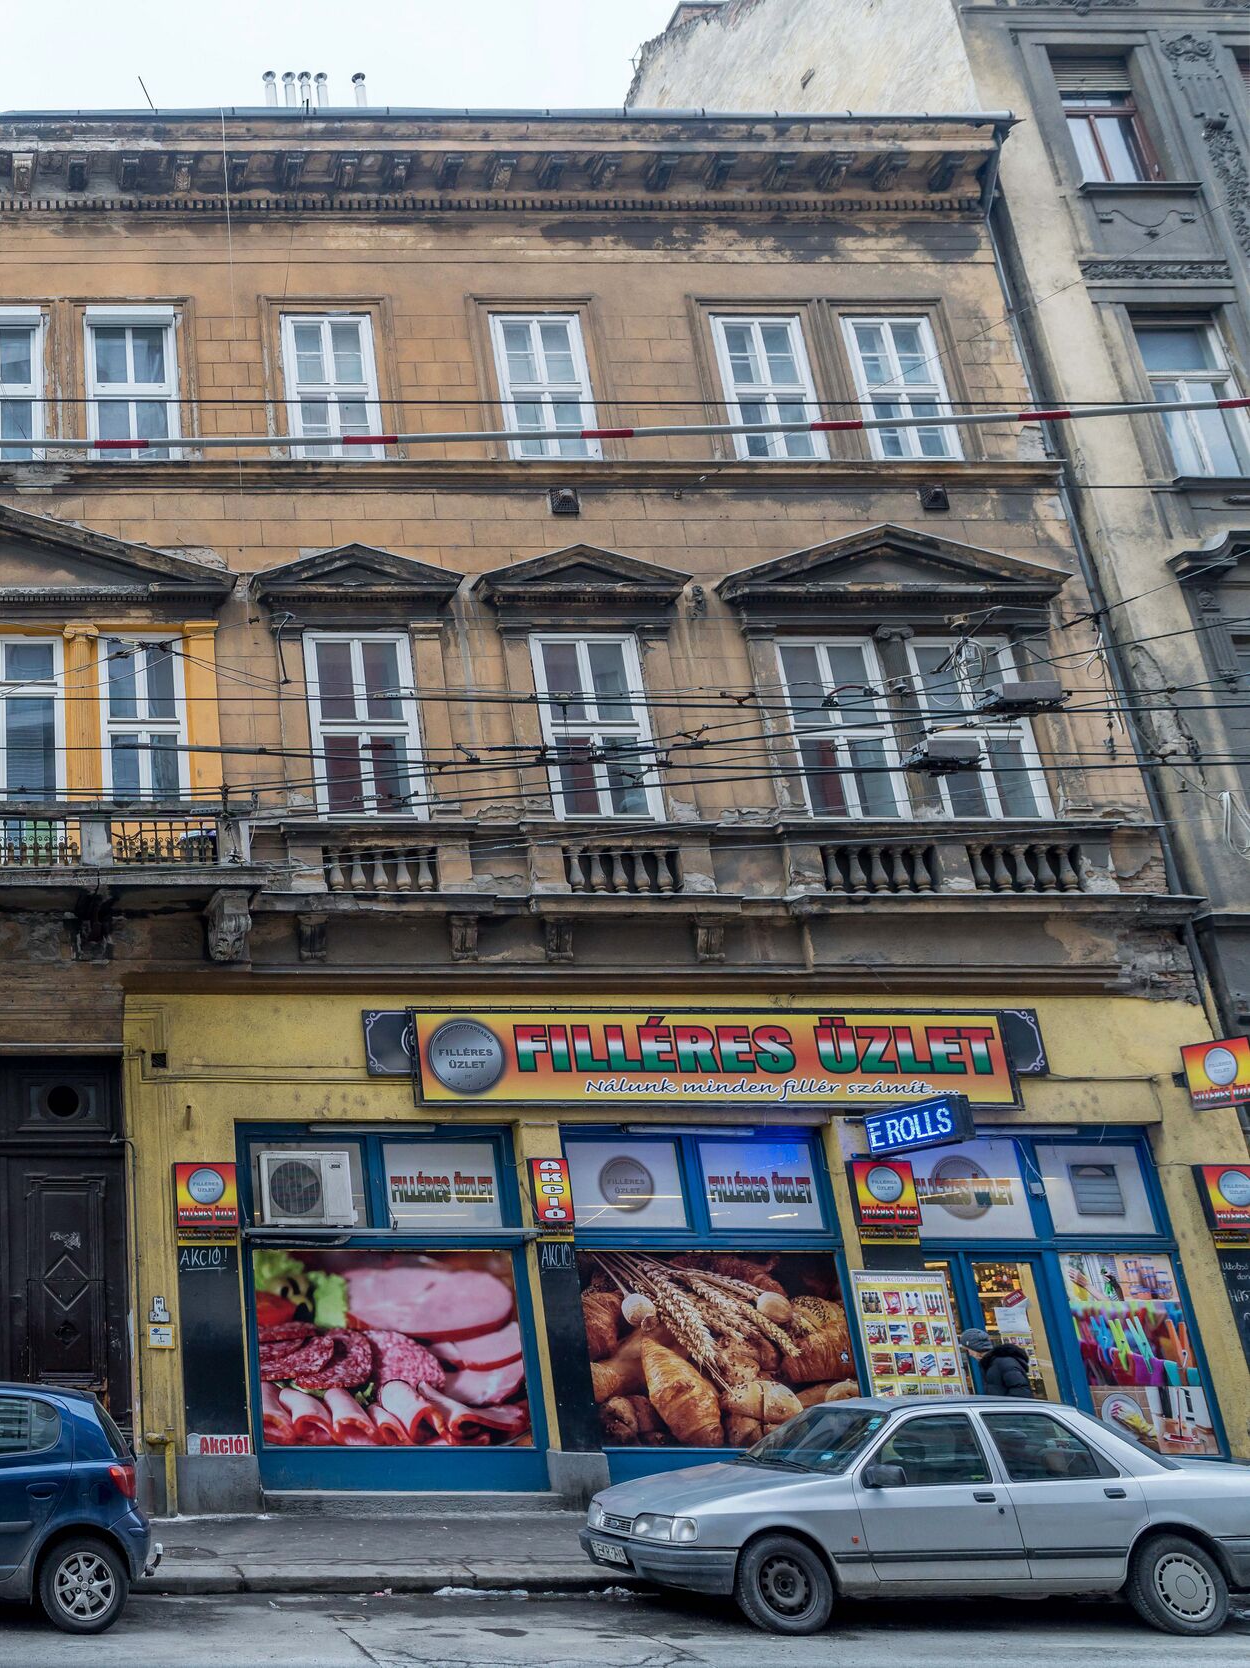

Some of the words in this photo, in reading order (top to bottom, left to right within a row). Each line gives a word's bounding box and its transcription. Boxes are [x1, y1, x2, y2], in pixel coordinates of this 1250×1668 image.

[438, 1048, 494, 1057] FILLÉRES
[512, 1016, 797, 1073] FILLÉRES
[813, 1016, 995, 1075] ÜZLET
[448, 1060, 486, 1069] ÜZLET
[586, 1078, 678, 1093] Nálunk
[683, 1078, 779, 1093] minden
[779, 1079, 841, 1101] fillér
[887, 1107, 952, 1145] ROLLS
[390, 1171, 451, 1204] FILLÉRES
[454, 1171, 494, 1204] ÜZLET
[539, 1160, 567, 1219] AKCIÓ
[708, 1171, 770, 1203] FILLÉRES
[771, 1171, 813, 1204] ÜZLET
[179, 1246, 228, 1267] AKCIÓ!
